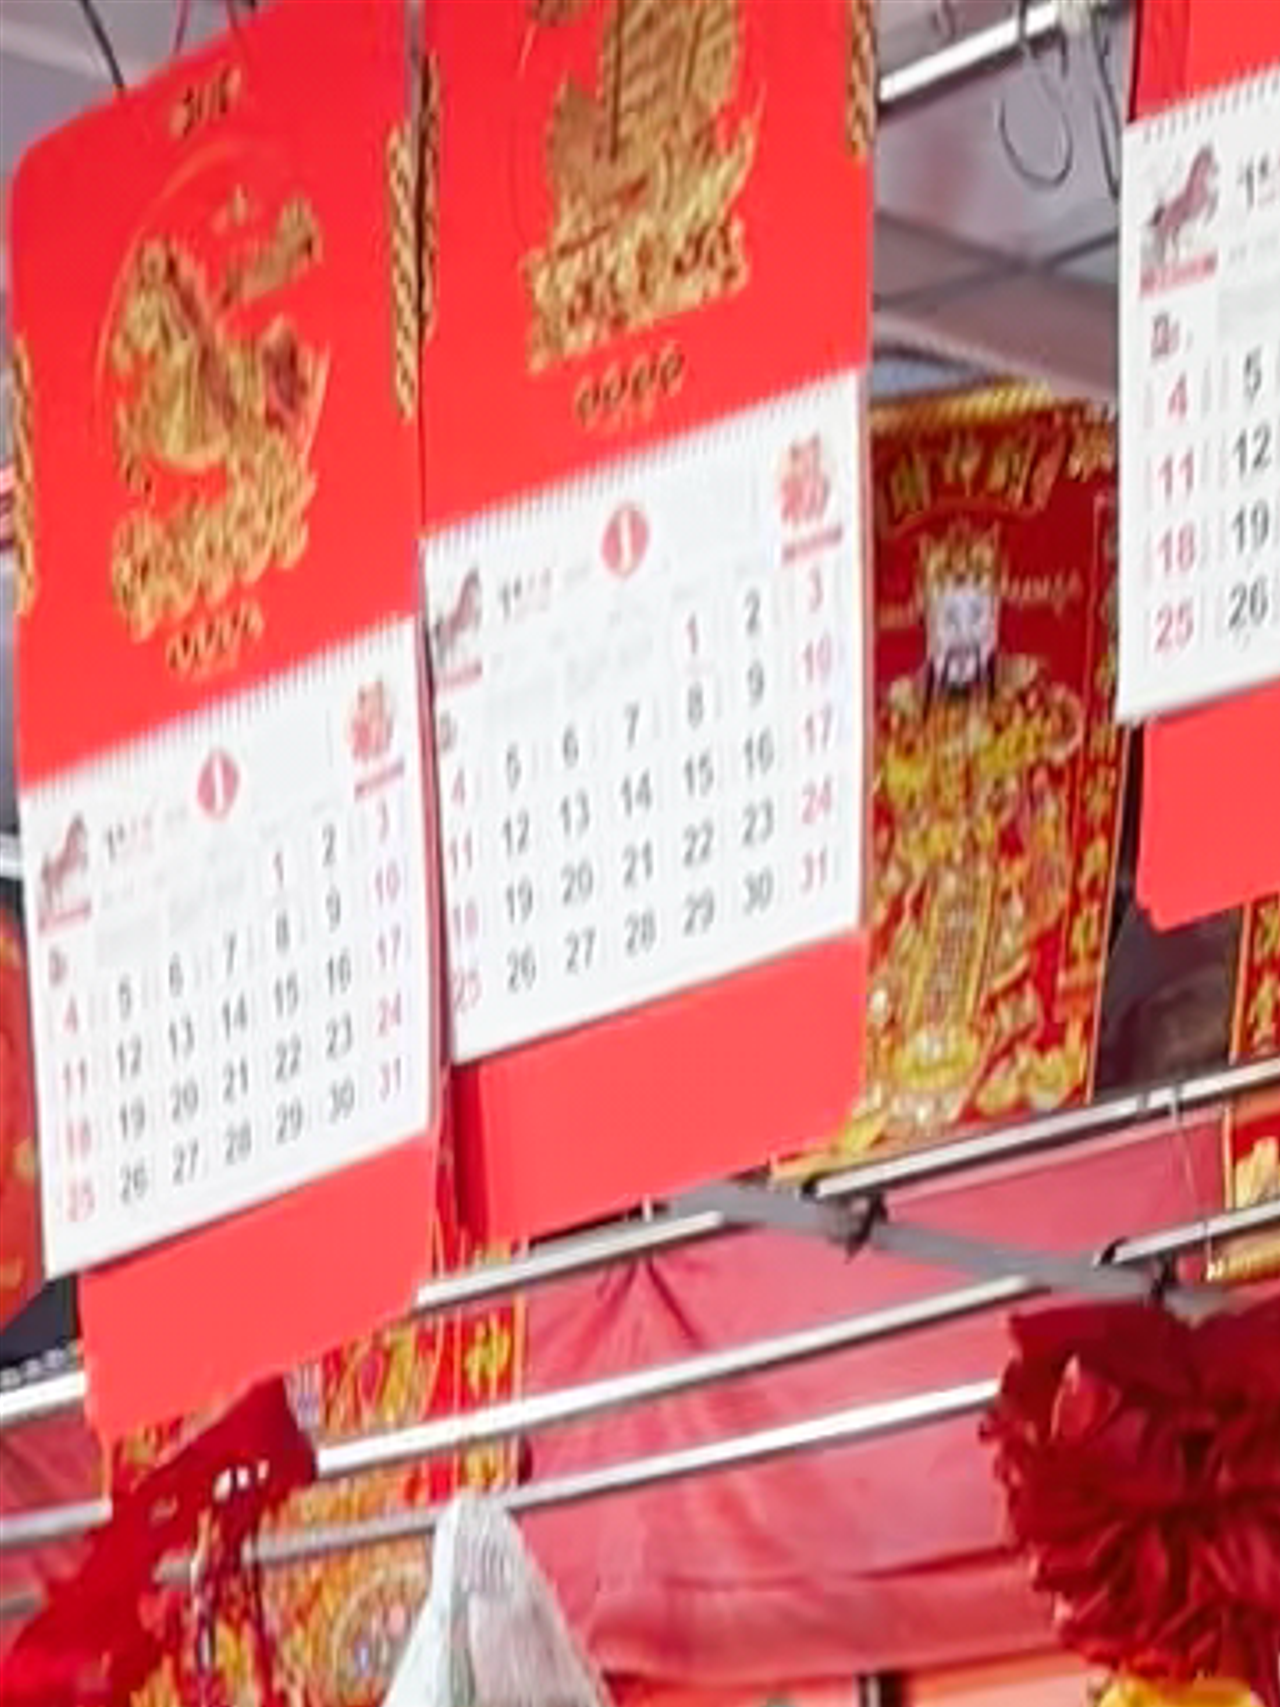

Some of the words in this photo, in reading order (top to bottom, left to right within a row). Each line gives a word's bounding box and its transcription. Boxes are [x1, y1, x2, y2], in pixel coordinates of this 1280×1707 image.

[1168, 373, 1187, 419] 4
[1244, 348, 1262, 403] 5
[1159, 448, 1194, 500] 11
[1234, 424, 1271, 477] 12
[1159, 524, 1196, 575] 18
[1233, 501, 1269, 552] 19
[746, 590, 760, 636] 2
[1156, 601, 1193, 652] 25
[1229, 578, 1268, 629] 26
[506, 744, 521, 792] 5
[563, 727, 579, 767] 6
[625, 703, 639, 748] 7
[688, 682, 704, 729] 8
[748, 661, 765, 705] 9
[503, 812, 529, 856] 12
[560, 790, 590, 835] 13
[621, 770, 652, 816] 14
[684, 752, 714, 795] 15
[744, 730, 774, 776] 16
[506, 879, 533, 923] 19
[562, 860, 593, 905] 20
[624, 840, 653, 887] 21
[684, 820, 714, 867] 22
[743, 799, 774, 846] 23
[507, 946, 536, 993] 26
[565, 928, 595, 973] 27
[625, 909, 656, 956] 28
[684, 890, 715, 935] 29
[744, 868, 774, 915] 30
